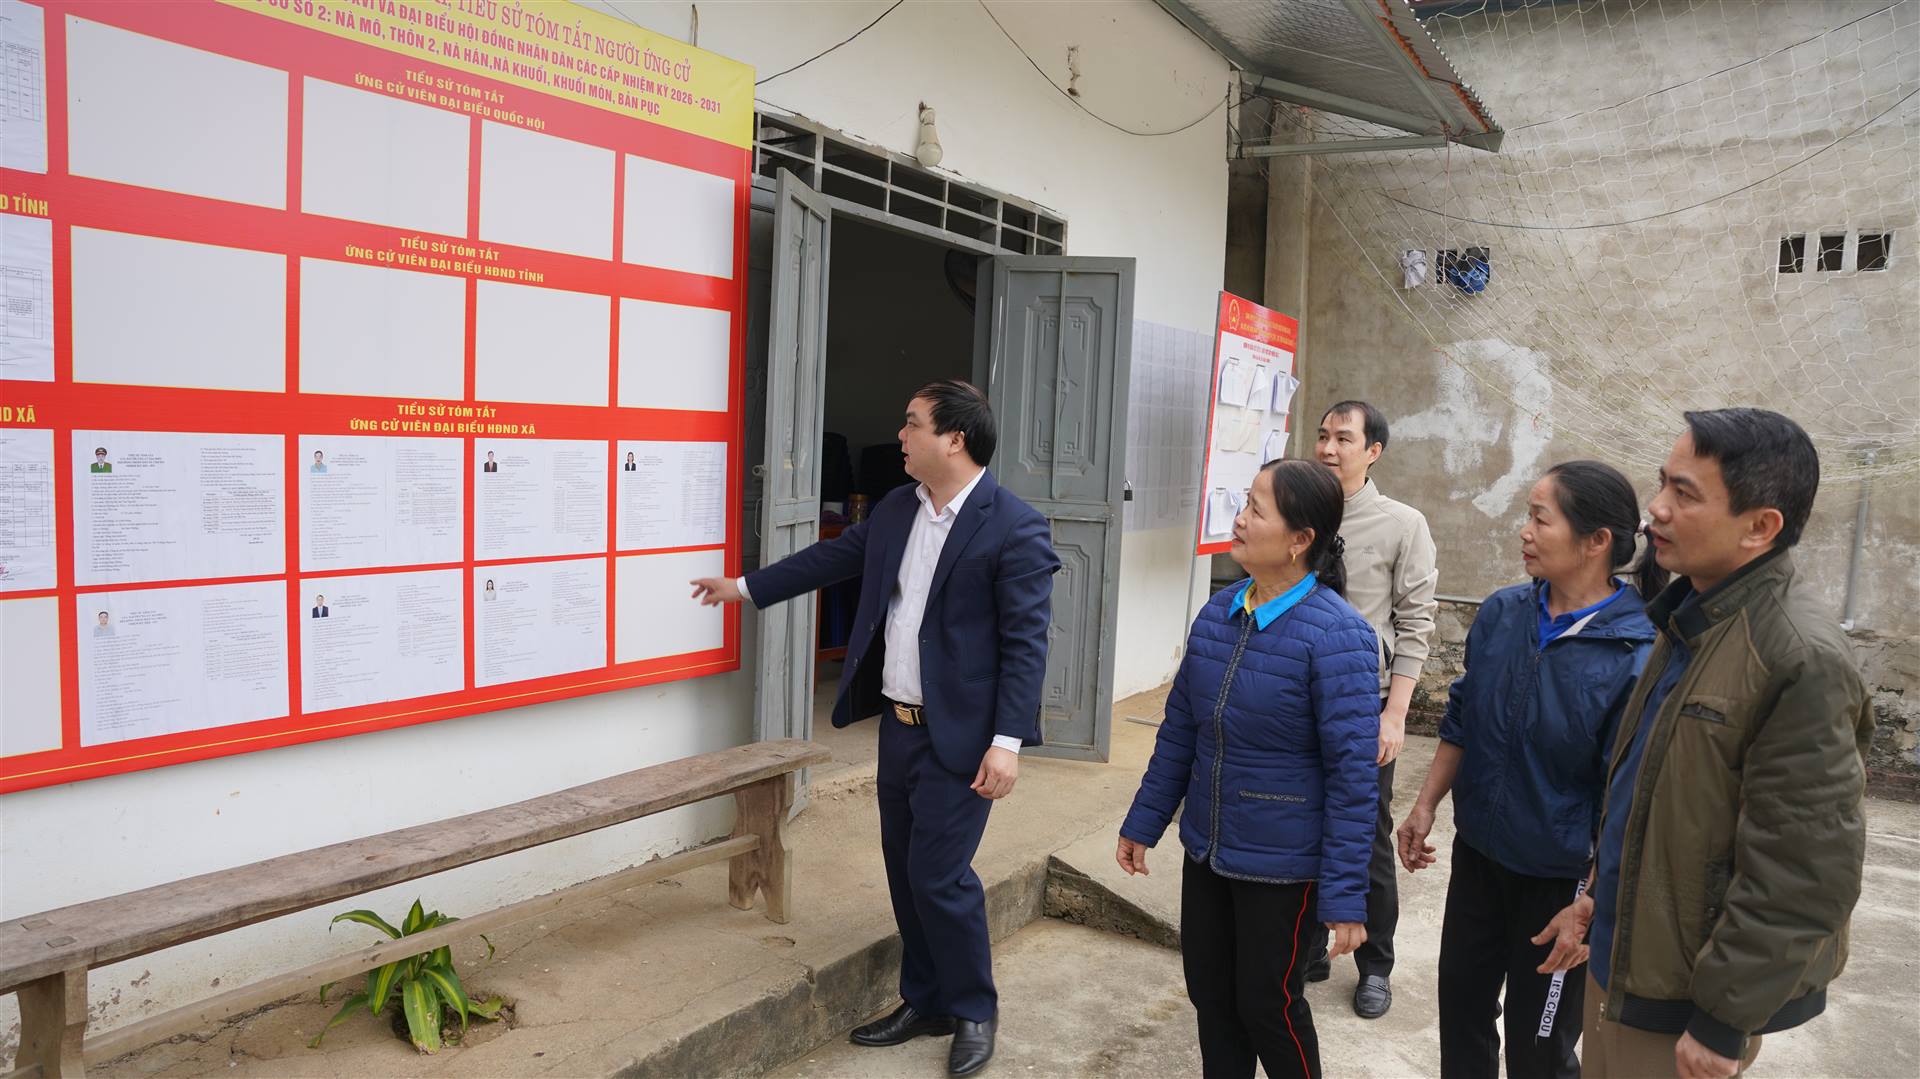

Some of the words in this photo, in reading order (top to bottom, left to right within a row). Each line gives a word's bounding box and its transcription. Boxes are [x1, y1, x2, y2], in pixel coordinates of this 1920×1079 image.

[335, 10, 355, 30] NÀ
[359, 16, 386, 41] MÔ,
[389, 26, 425, 50] THÔN
[443, 41, 461, 60] NÀ
[501, 1, 523, 29] SỬ
[525, 12, 560, 41] TÓM
[562, 20, 592, 51] TẮT
[594, 36, 641, 67] NGƯỜI
[643, 48, 671, 76] ỨNG
[673, 58, 691, 83] CỬ
[399, 4, 422, 26] ĐẠI
[425, 11, 455, 34] BIỂU
[458, 22, 479, 43] HỘI
[517, 40, 549, 62] NHÂN
[576, 59, 598, 77] CÁC
[600, 64, 621, 83] CẤP
[622, 73, 655, 94] NHIỆM
[670, 88, 693, 106] 2026
[700, 97, 721, 114] 2031
[355, 71, 384, 90] ỨNG
[386, 81, 406, 95] CỬ
[407, 87, 437, 104] VIÊN
[439, 95, 461, 111] ĐẠI
[463, 101, 491, 117] BIỂU
[493, 109, 524, 126] QUỐC
[526, 116, 546, 131] HỘI
[405, 69, 434, 86] TIỂU
[436, 78, 455, 92] SỬ
[456, 83, 482, 99] TÓM
[483, 89, 505, 105] TẮT
[13, 192, 49, 217] TỈNH
[345, 244, 374, 260] ỨNG
[377, 249, 396, 263] CỬ
[398, 252, 427, 268] VIÊN
[430, 257, 451, 272] ĐẠI
[454, 259, 481, 275] BIỂU
[484, 265, 516, 280] HĐND
[518, 268, 544, 283] TỈNH
[400, 235, 429, 251] TIỂU
[431, 240, 449, 254] SỬ
[450, 244, 476, 258] TÓM
[478, 247, 500, 261] TẮT
[16, 404, 36, 423] XÃ
[350, 417, 378, 431] ỨNG
[381, 418, 400, 432] CỬ
[402, 419, 431, 432] VIÊN
[433, 421, 455, 435] ĐẠI
[457, 419, 484, 433] BIỂU
[487, 423, 519, 434] HĐND
[521, 424, 536, 434] XÃ
[397, 401, 425, 416] TIỂU
[428, 402, 445, 416] SỬ
[448, 404, 473, 418] TÓM
[476, 405, 497, 418] TẮT
